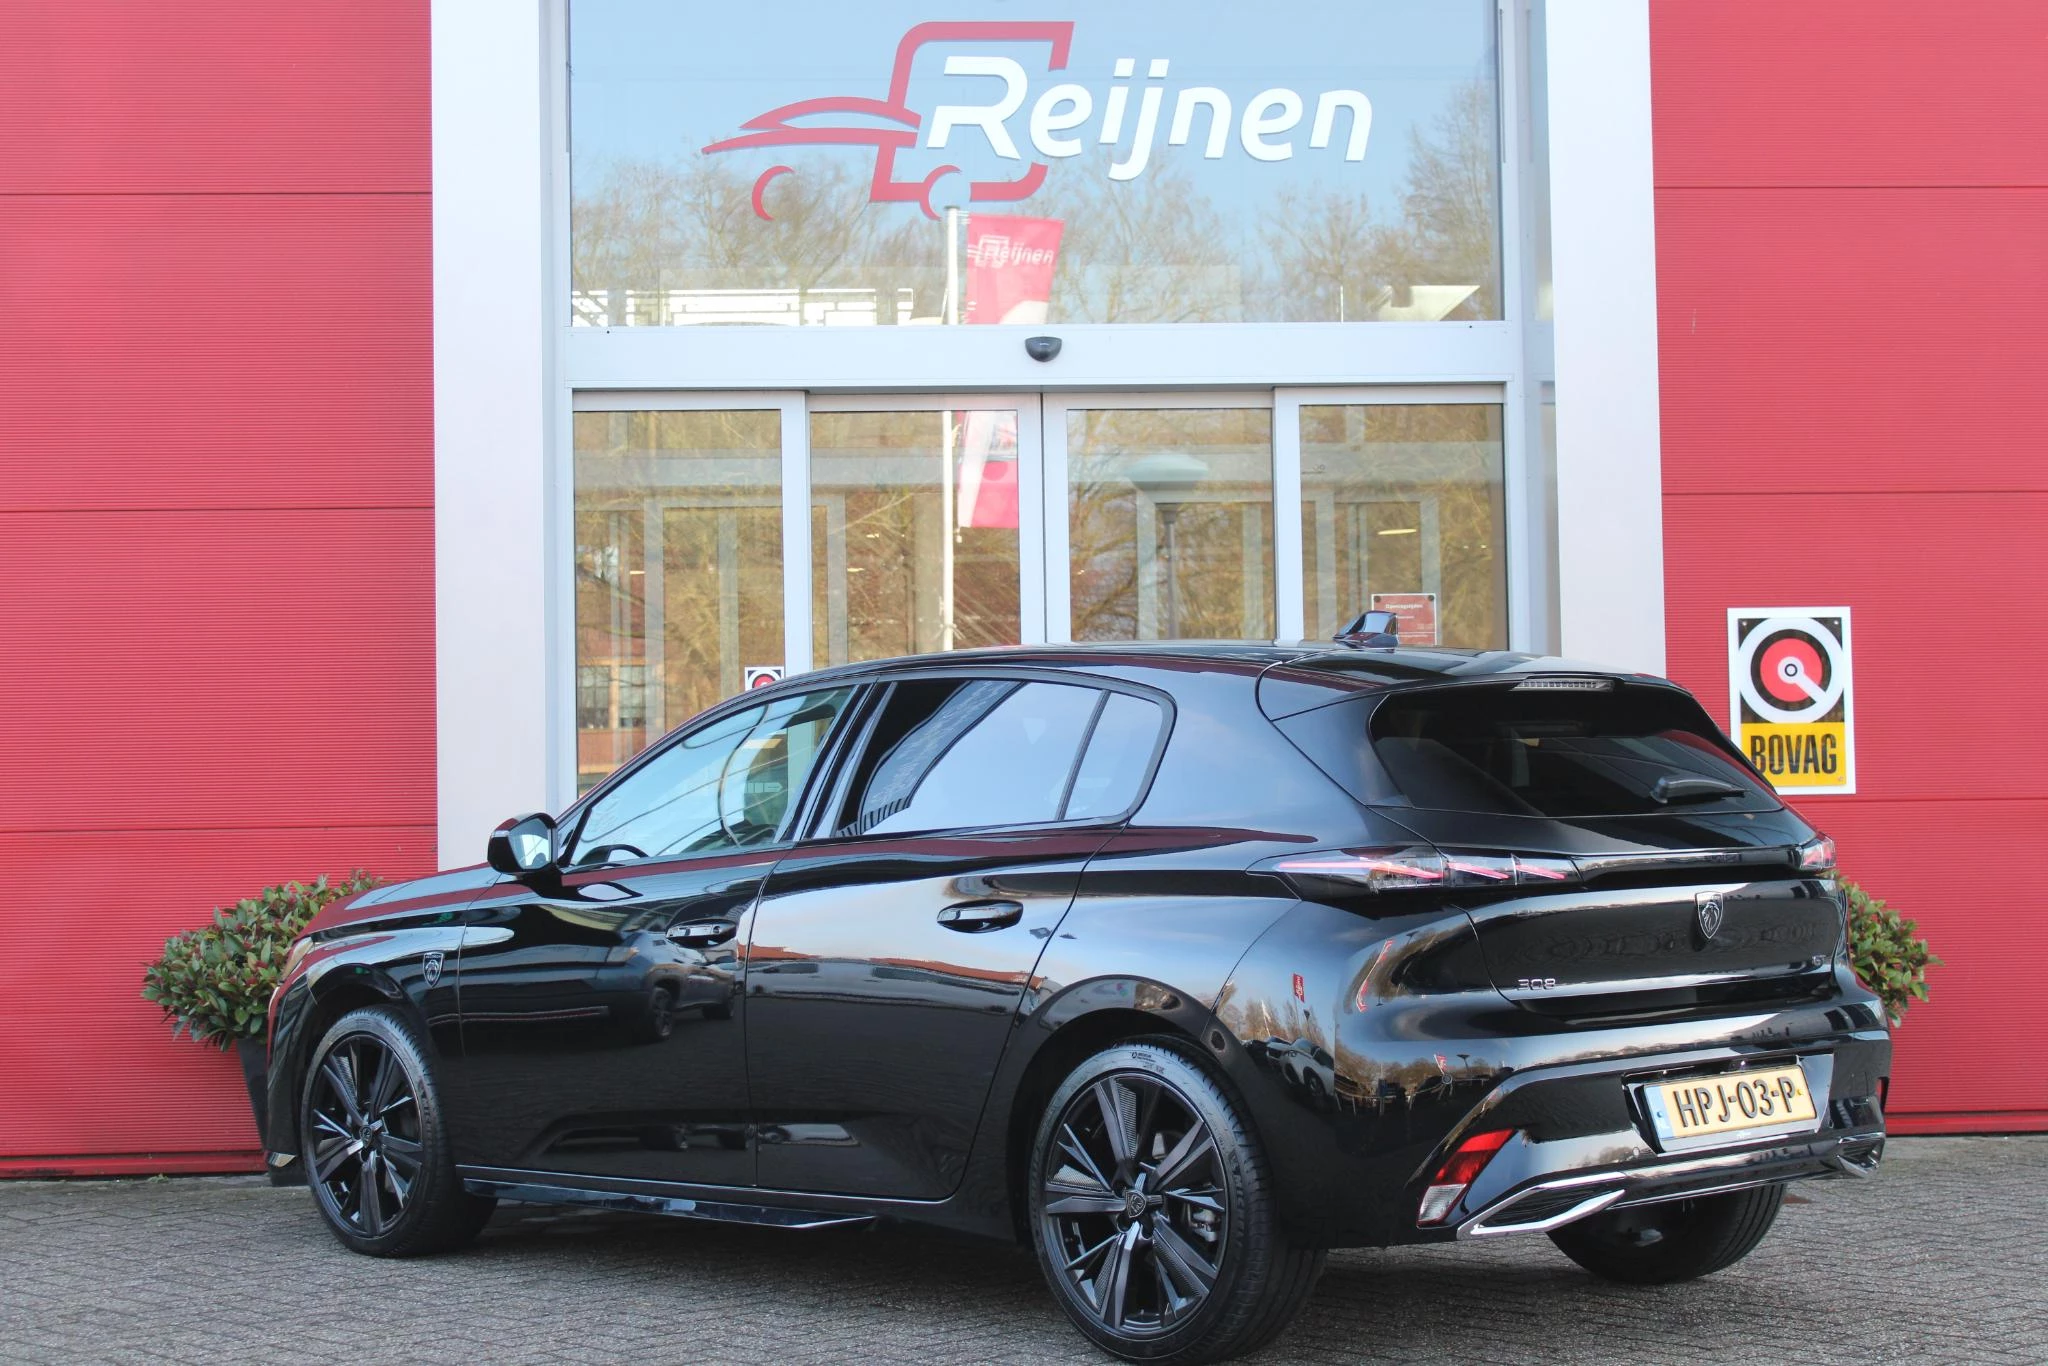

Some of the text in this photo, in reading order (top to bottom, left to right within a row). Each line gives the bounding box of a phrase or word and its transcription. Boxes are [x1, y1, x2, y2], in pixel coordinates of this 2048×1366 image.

[926, 55, 1373, 181] Reijnen
[984, 241, 1055, 267] Reijnen
[1750, 734, 1837, 775] BOVAG
[1517, 978, 1556, 990] 308
[1673, 1076, 1796, 1128] HPJ-03-P
